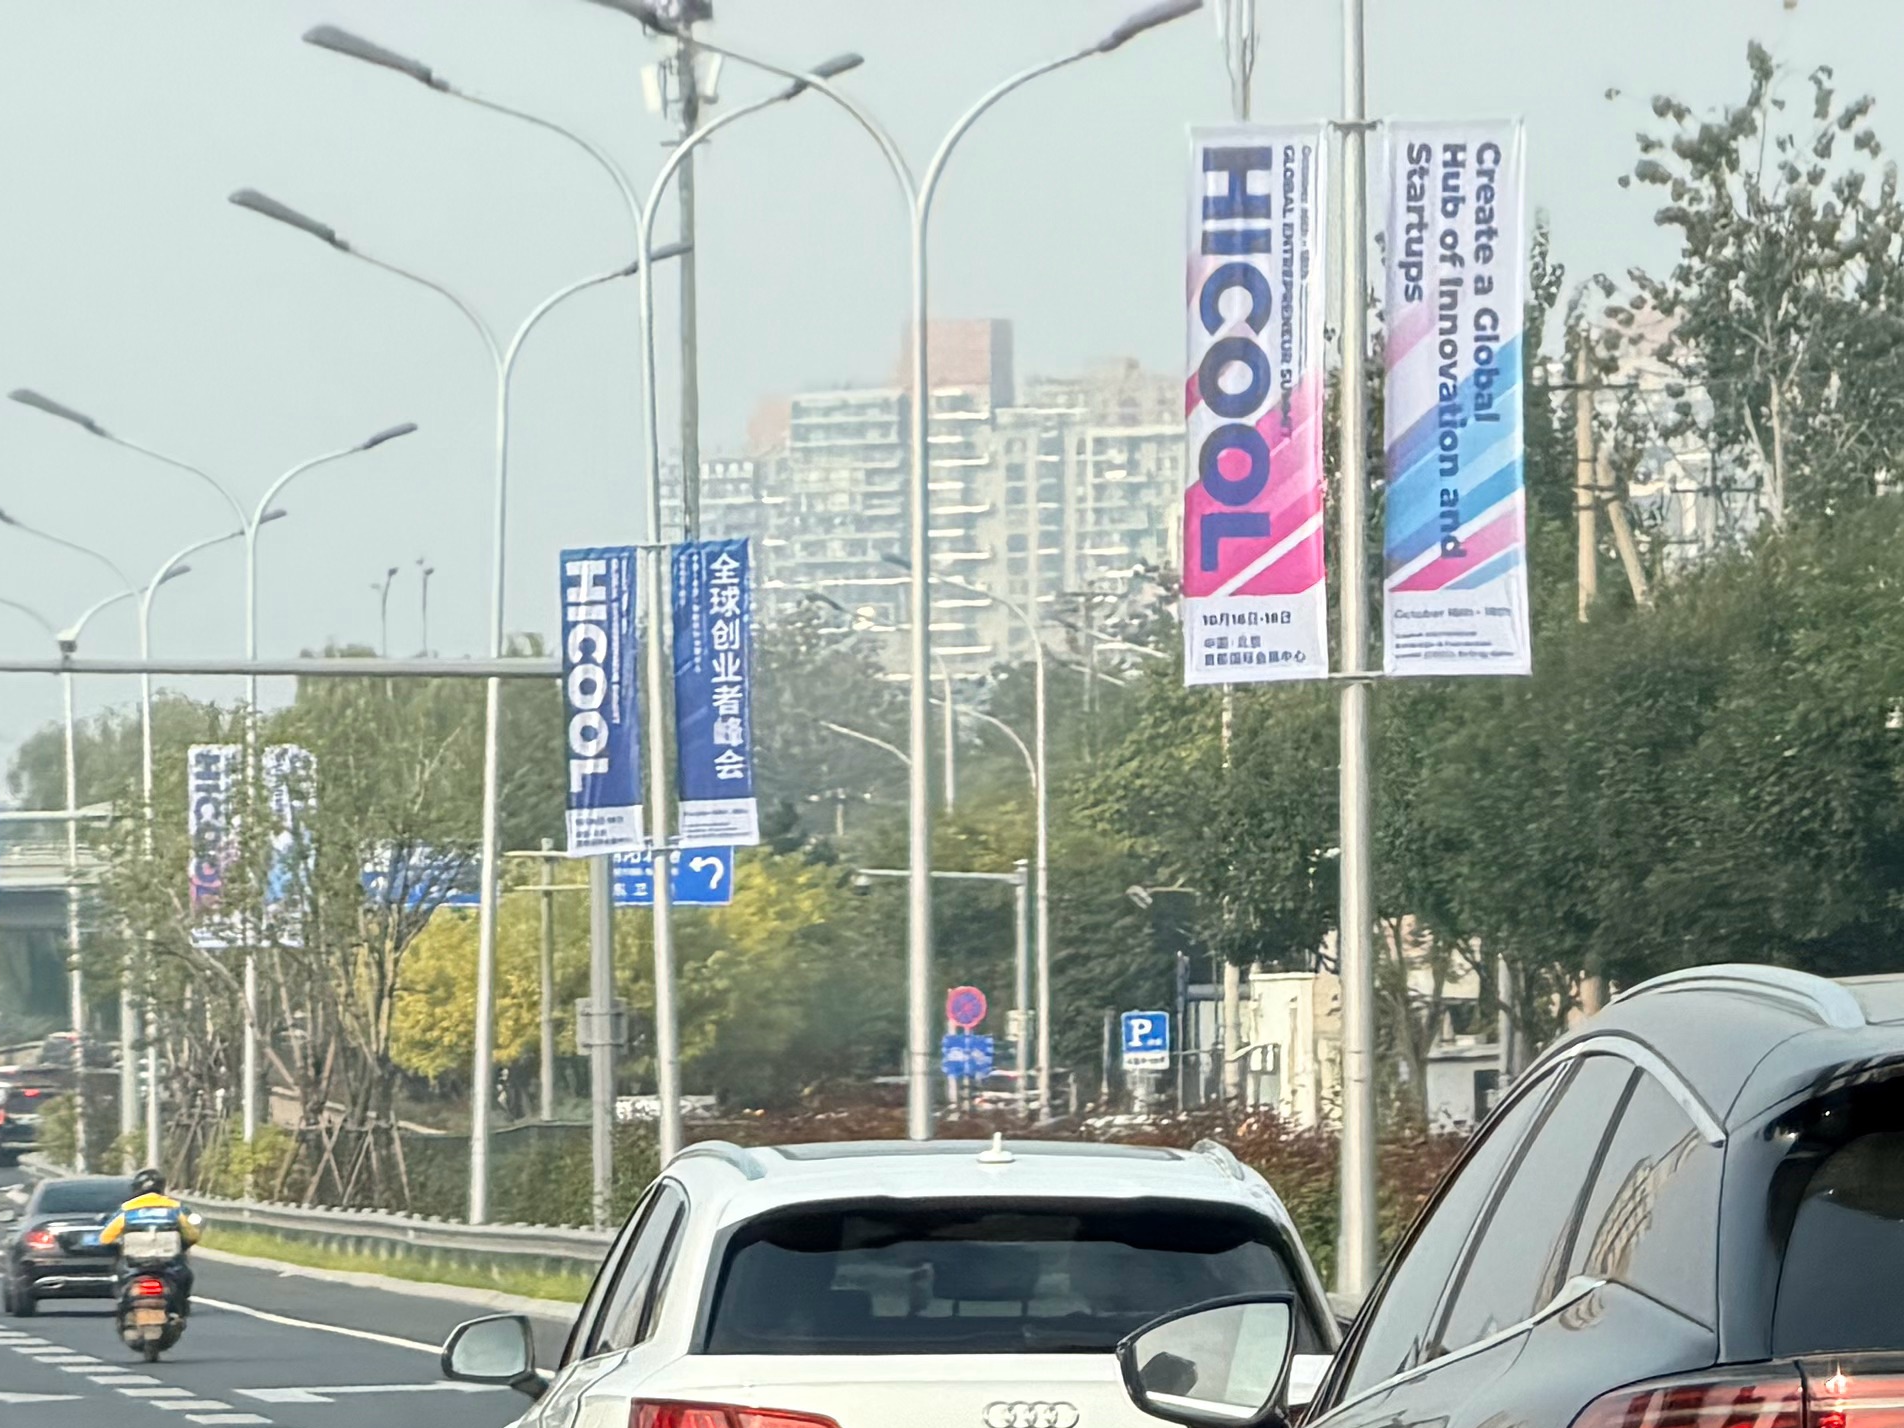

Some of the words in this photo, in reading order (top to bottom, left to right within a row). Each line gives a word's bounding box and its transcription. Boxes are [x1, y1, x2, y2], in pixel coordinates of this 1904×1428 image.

[1398, 142, 1432, 303] Startups
[1441, 143, 1467, 219] Hub
[1474, 142, 1501, 264] Create
[1439, 228, 1465, 268] of
[1474, 274, 1494, 295] a
[1200, 146, 1273, 573] HICOOL
[1438, 277, 1467, 477] Innovation
[1473, 307, 1500, 422] Global
[1440, 488, 1467, 558] and
[565, 559, 609, 793] HICOOL
[709, 552, 747, 780] 全球创业者峰会
[1128, 1018, 1153, 1047] P
